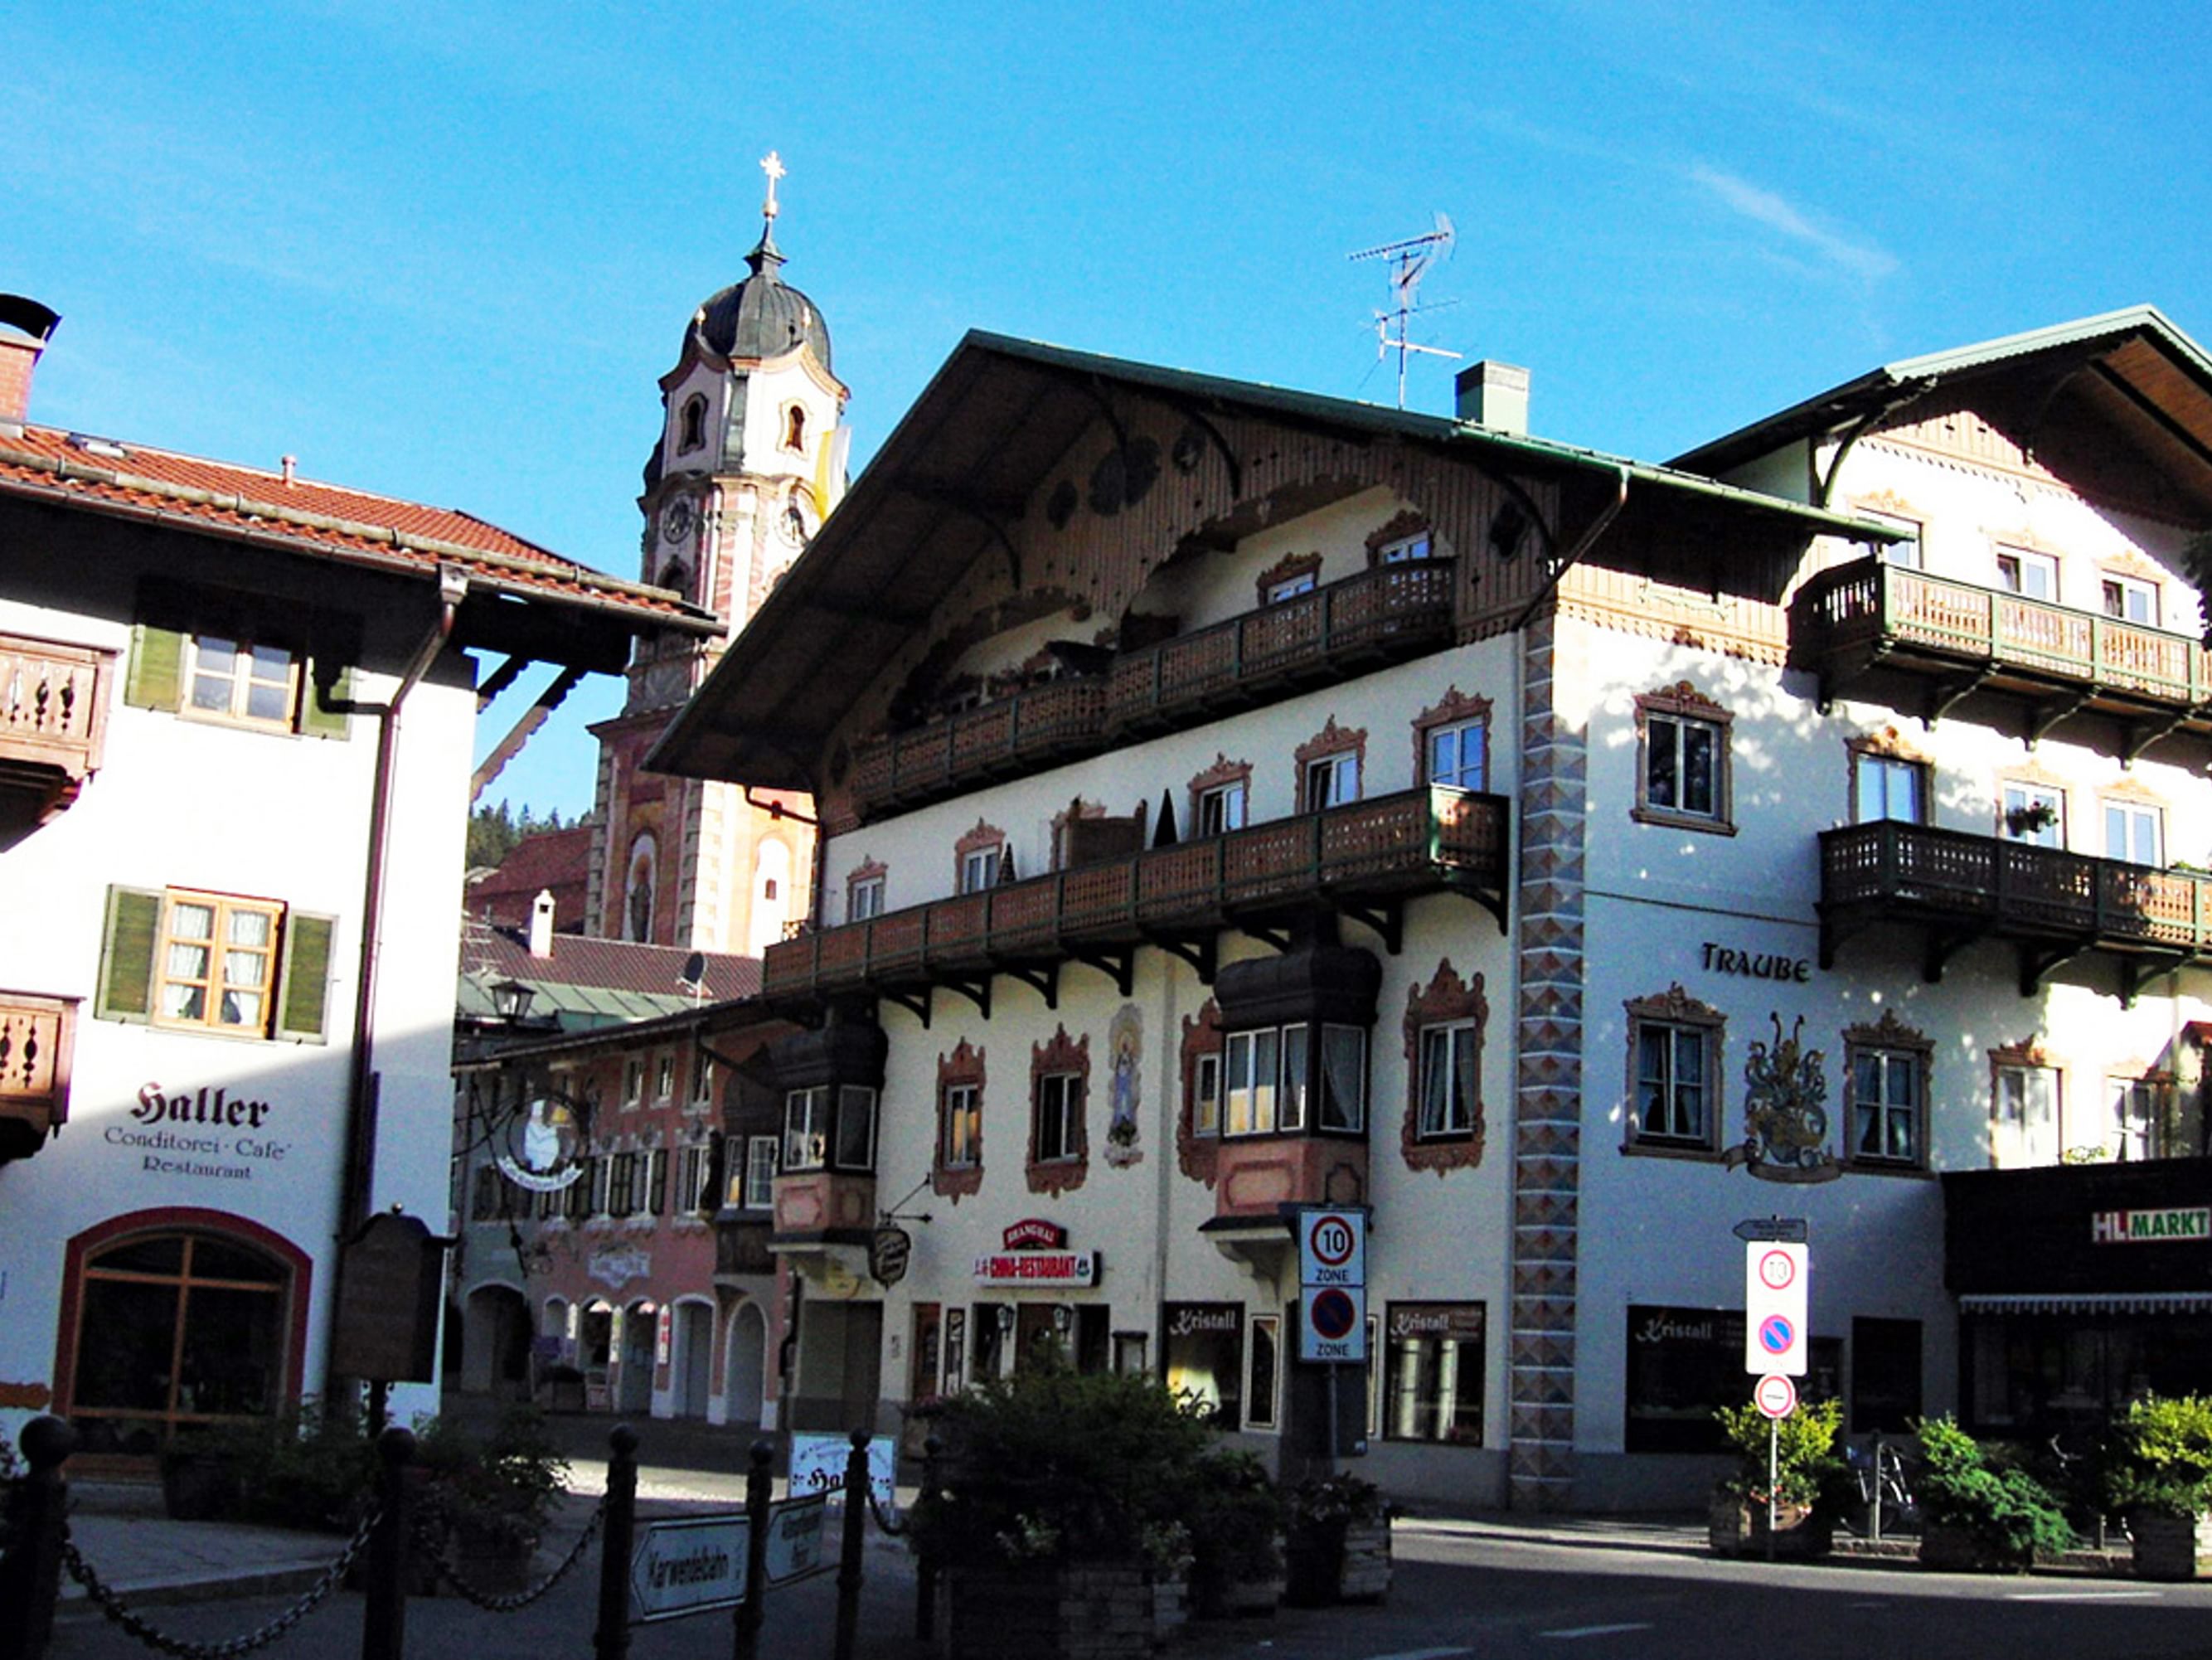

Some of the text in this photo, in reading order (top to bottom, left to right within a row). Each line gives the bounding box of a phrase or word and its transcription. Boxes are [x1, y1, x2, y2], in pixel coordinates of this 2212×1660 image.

[1702, 942, 1810, 983] TRAUBE
[129, 1081, 270, 1129] Haller
[104, 1126, 220, 1153] Conditorei
[143, 1155, 251, 1180] Restaurant
[1007, 1224, 1055, 1242] SHANGHAI
[2093, 1211, 2208, 1243] HL MARKT
[1323, 1230, 1346, 1253] 10
[1316, 1269, 1349, 1282] ZONE
[1169, 1309, 1235, 1336] Kristall
[1390, 1313, 1449, 1336] Kristall
[1635, 1318, 1712, 1342] Kristall
[1317, 1342, 1350, 1357] ZONE
